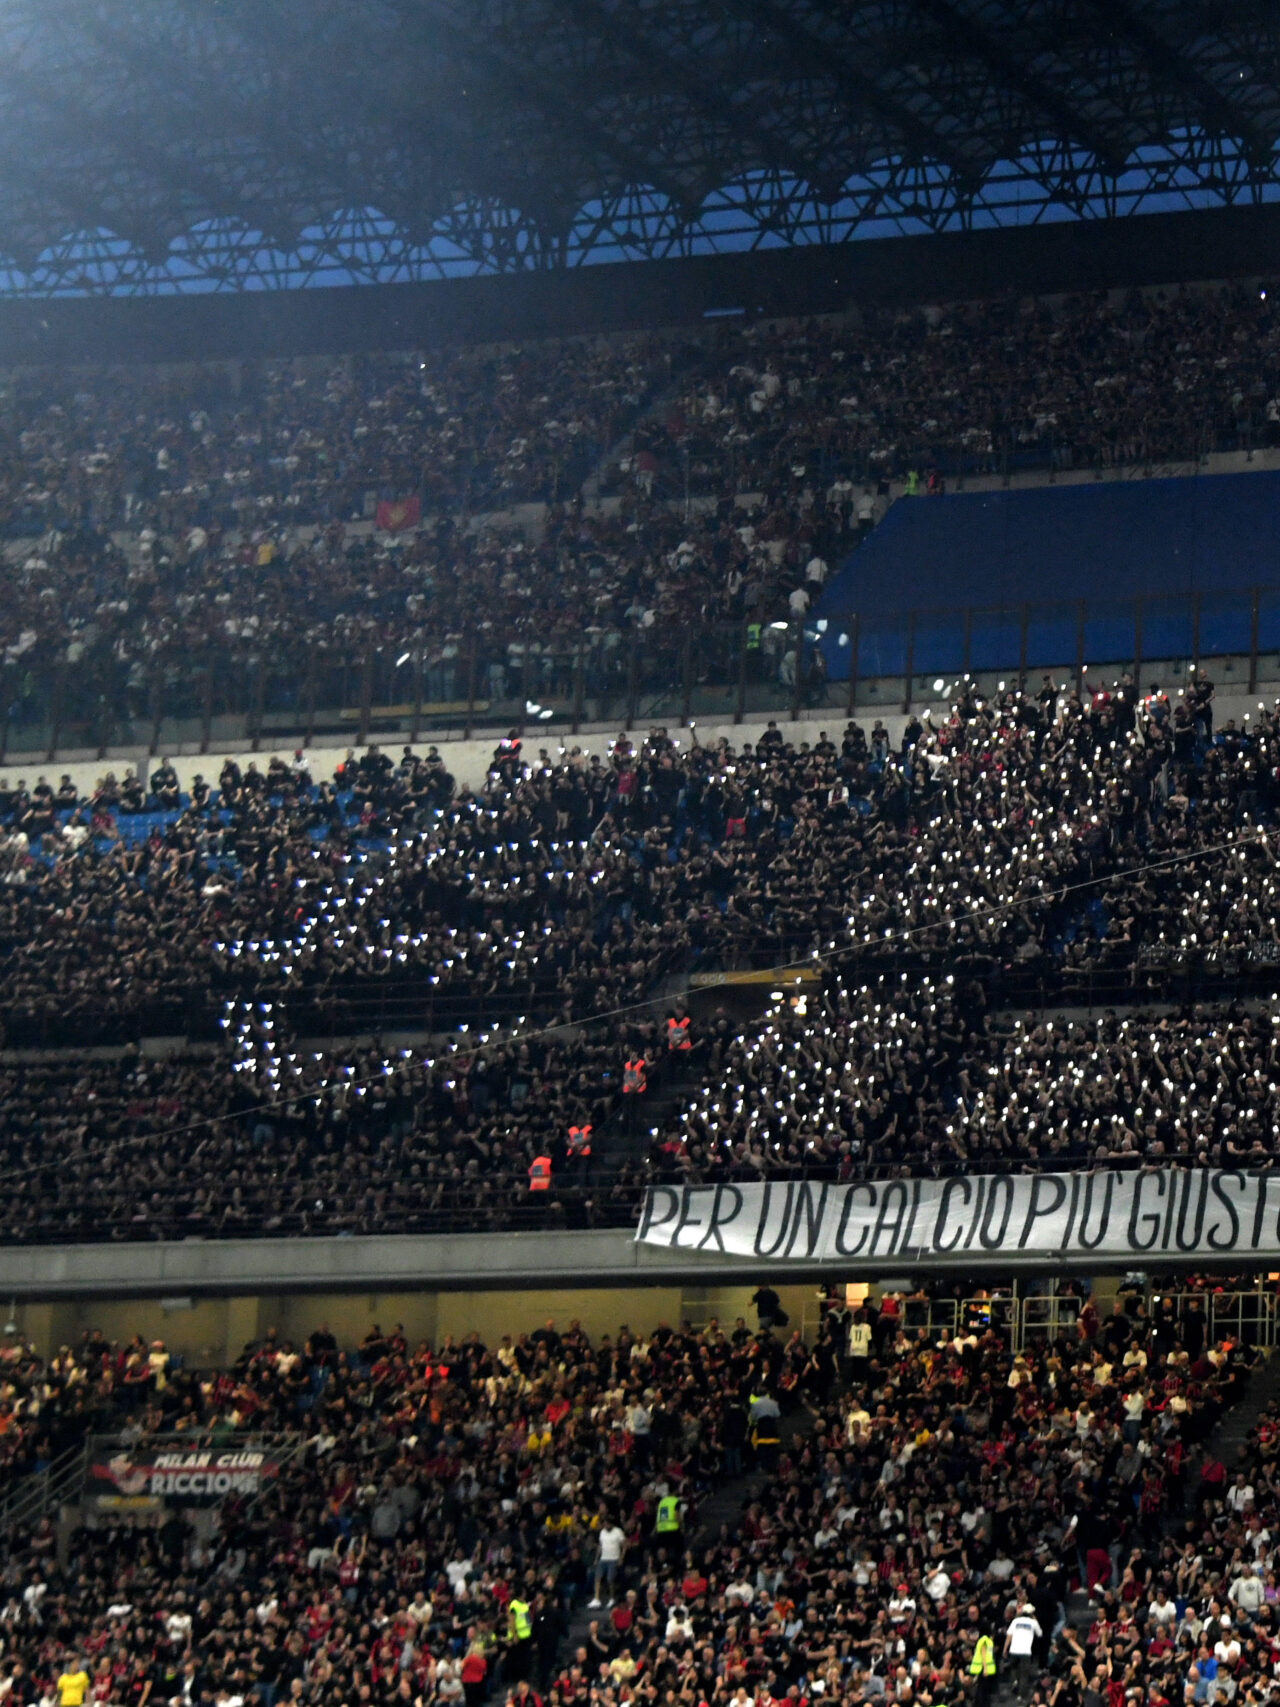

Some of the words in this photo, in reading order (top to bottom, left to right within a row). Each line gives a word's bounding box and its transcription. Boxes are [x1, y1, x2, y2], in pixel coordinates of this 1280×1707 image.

[641, 1184, 742, 1253] PER
[754, 1181, 828, 1257] UN
[836, 1175, 1014, 1256] CALCIO
[154, 1452, 212, 1469] MILAN
[216, 1452, 264, 1469] CLUB
